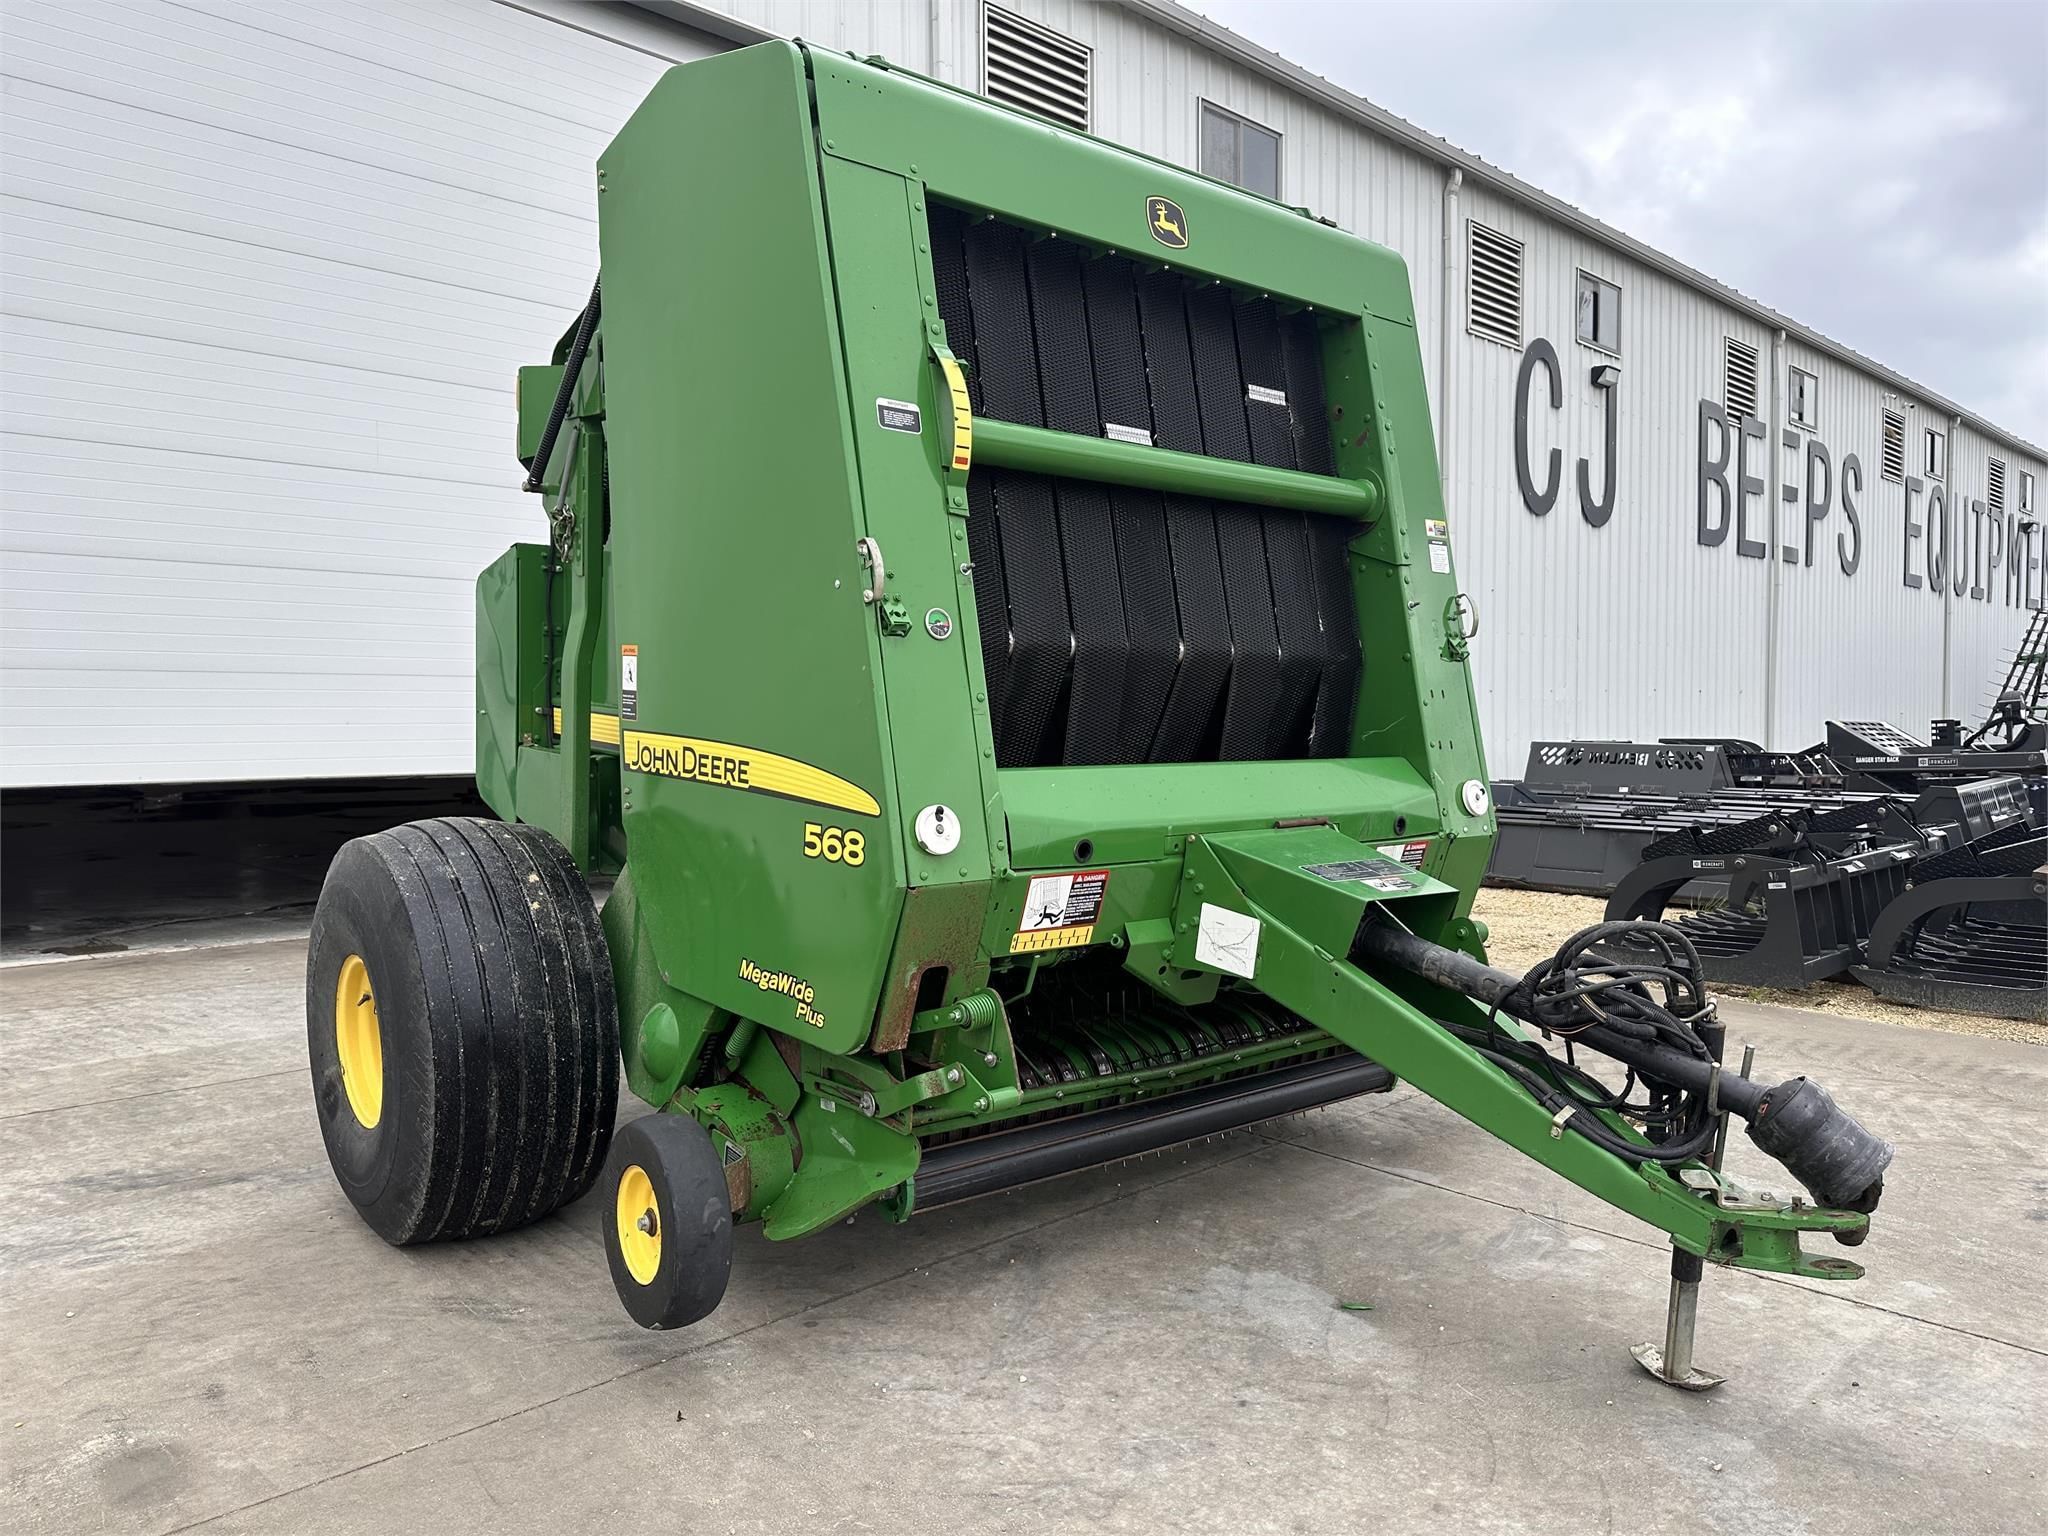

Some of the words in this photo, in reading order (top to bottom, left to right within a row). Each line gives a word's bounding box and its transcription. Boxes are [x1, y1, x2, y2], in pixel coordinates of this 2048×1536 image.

[1516, 337, 1617, 528] CJ
[1698, 398, 1863, 576] BEEPS
[632, 740, 679, 773] JOHN
[682, 746, 750, 785] DEERE
[804, 821, 865, 867] 568
[1083, 874, 1105, 882] DANGER
[739, 958, 814, 1003] MegaWide
[795, 1002, 825, 1028] Plus
